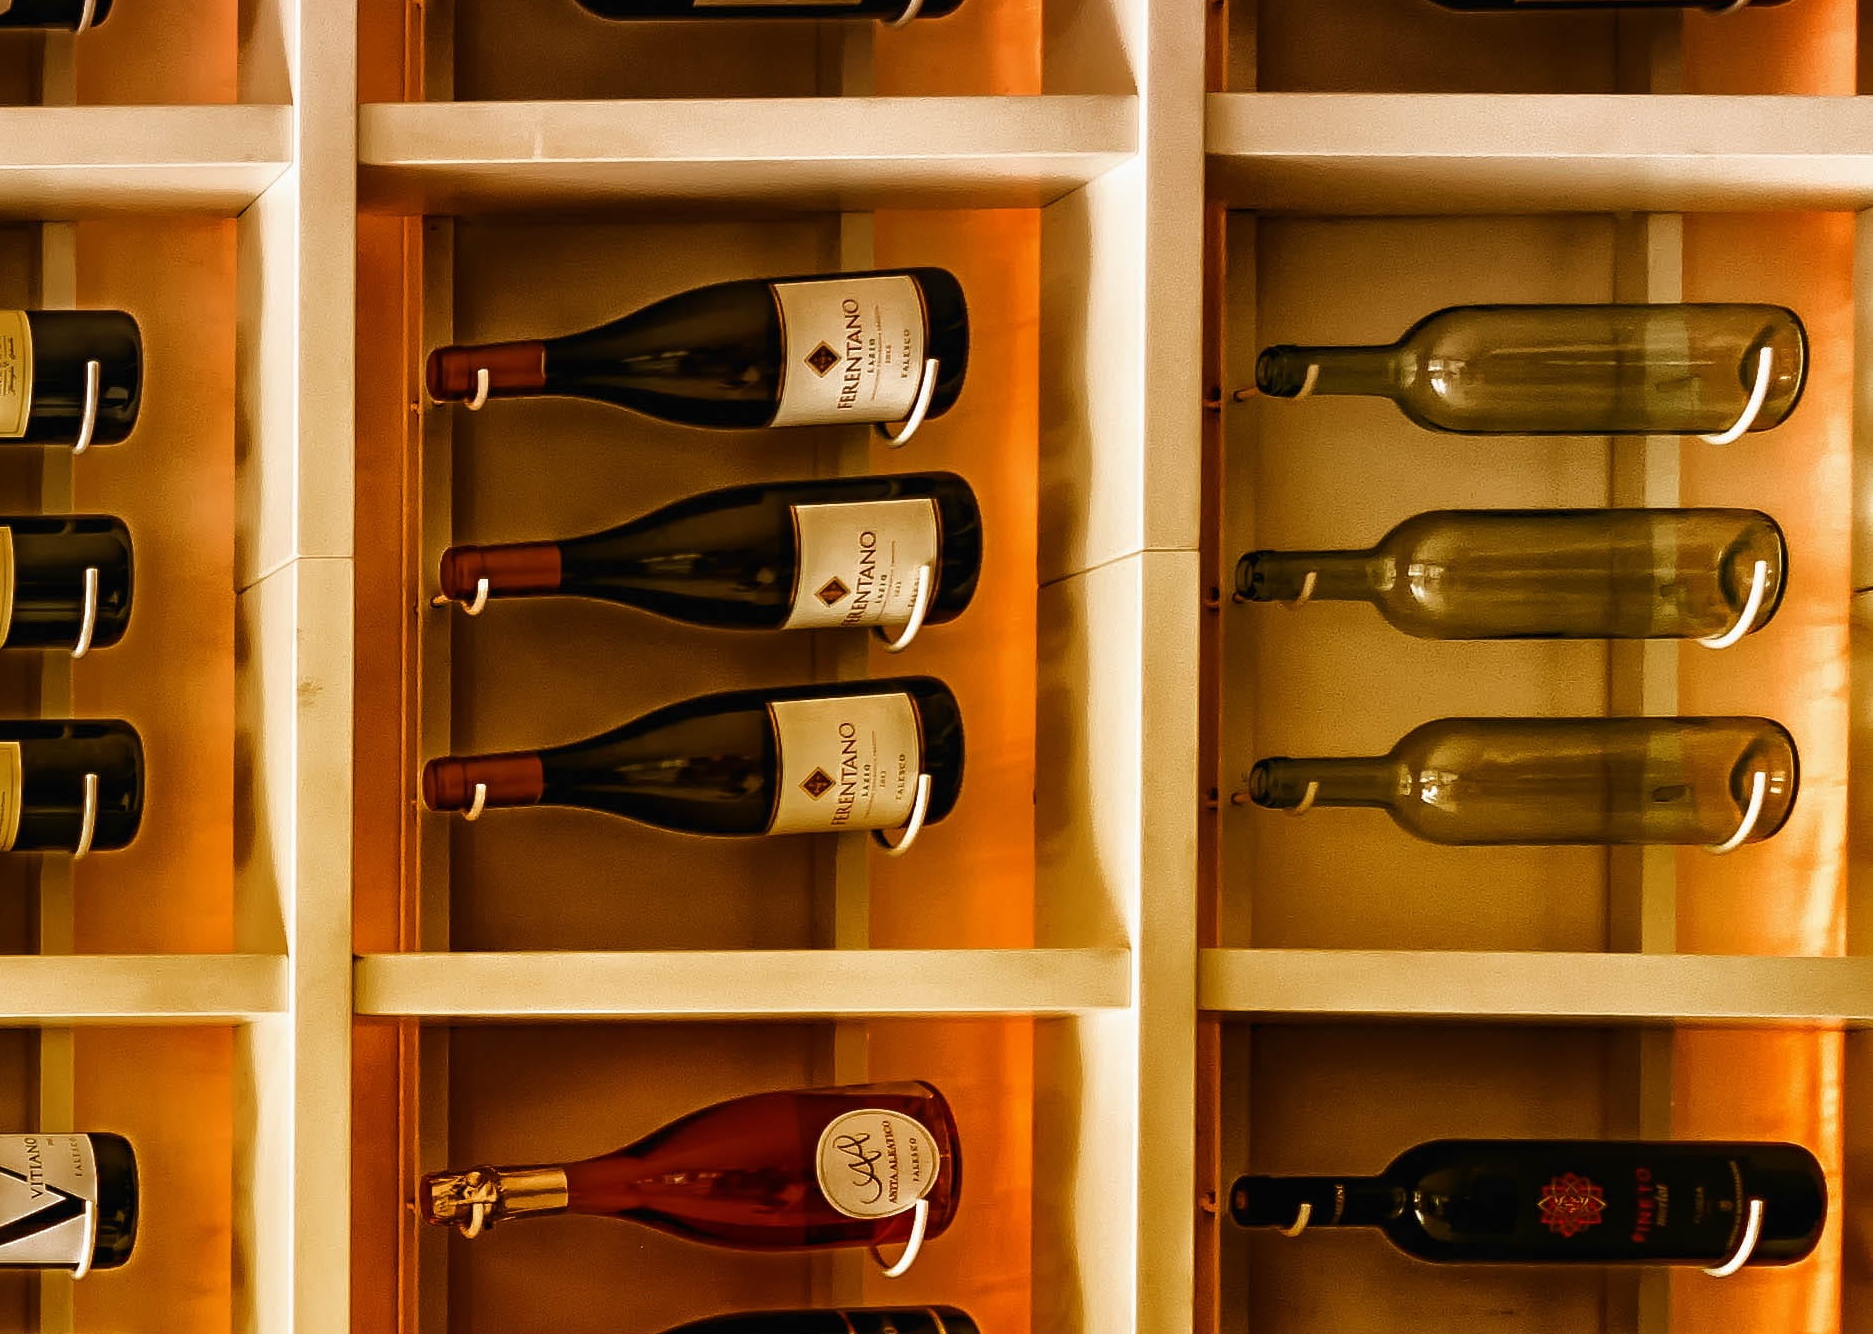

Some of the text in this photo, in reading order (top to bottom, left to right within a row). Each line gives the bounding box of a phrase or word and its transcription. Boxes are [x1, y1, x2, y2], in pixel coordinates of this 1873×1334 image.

[837, 299, 863, 409] FERENTANO
[867, 338, 876, 374] LAZIO
[875, 573, 888, 605] LAZIO
[829, 723, 858, 826] FERENTANO
[861, 763, 871, 798] LAZIO
[24, 1137, 45, 1199] VITIANO
[881, 1121, 899, 1204] ANITA ALEATICO
